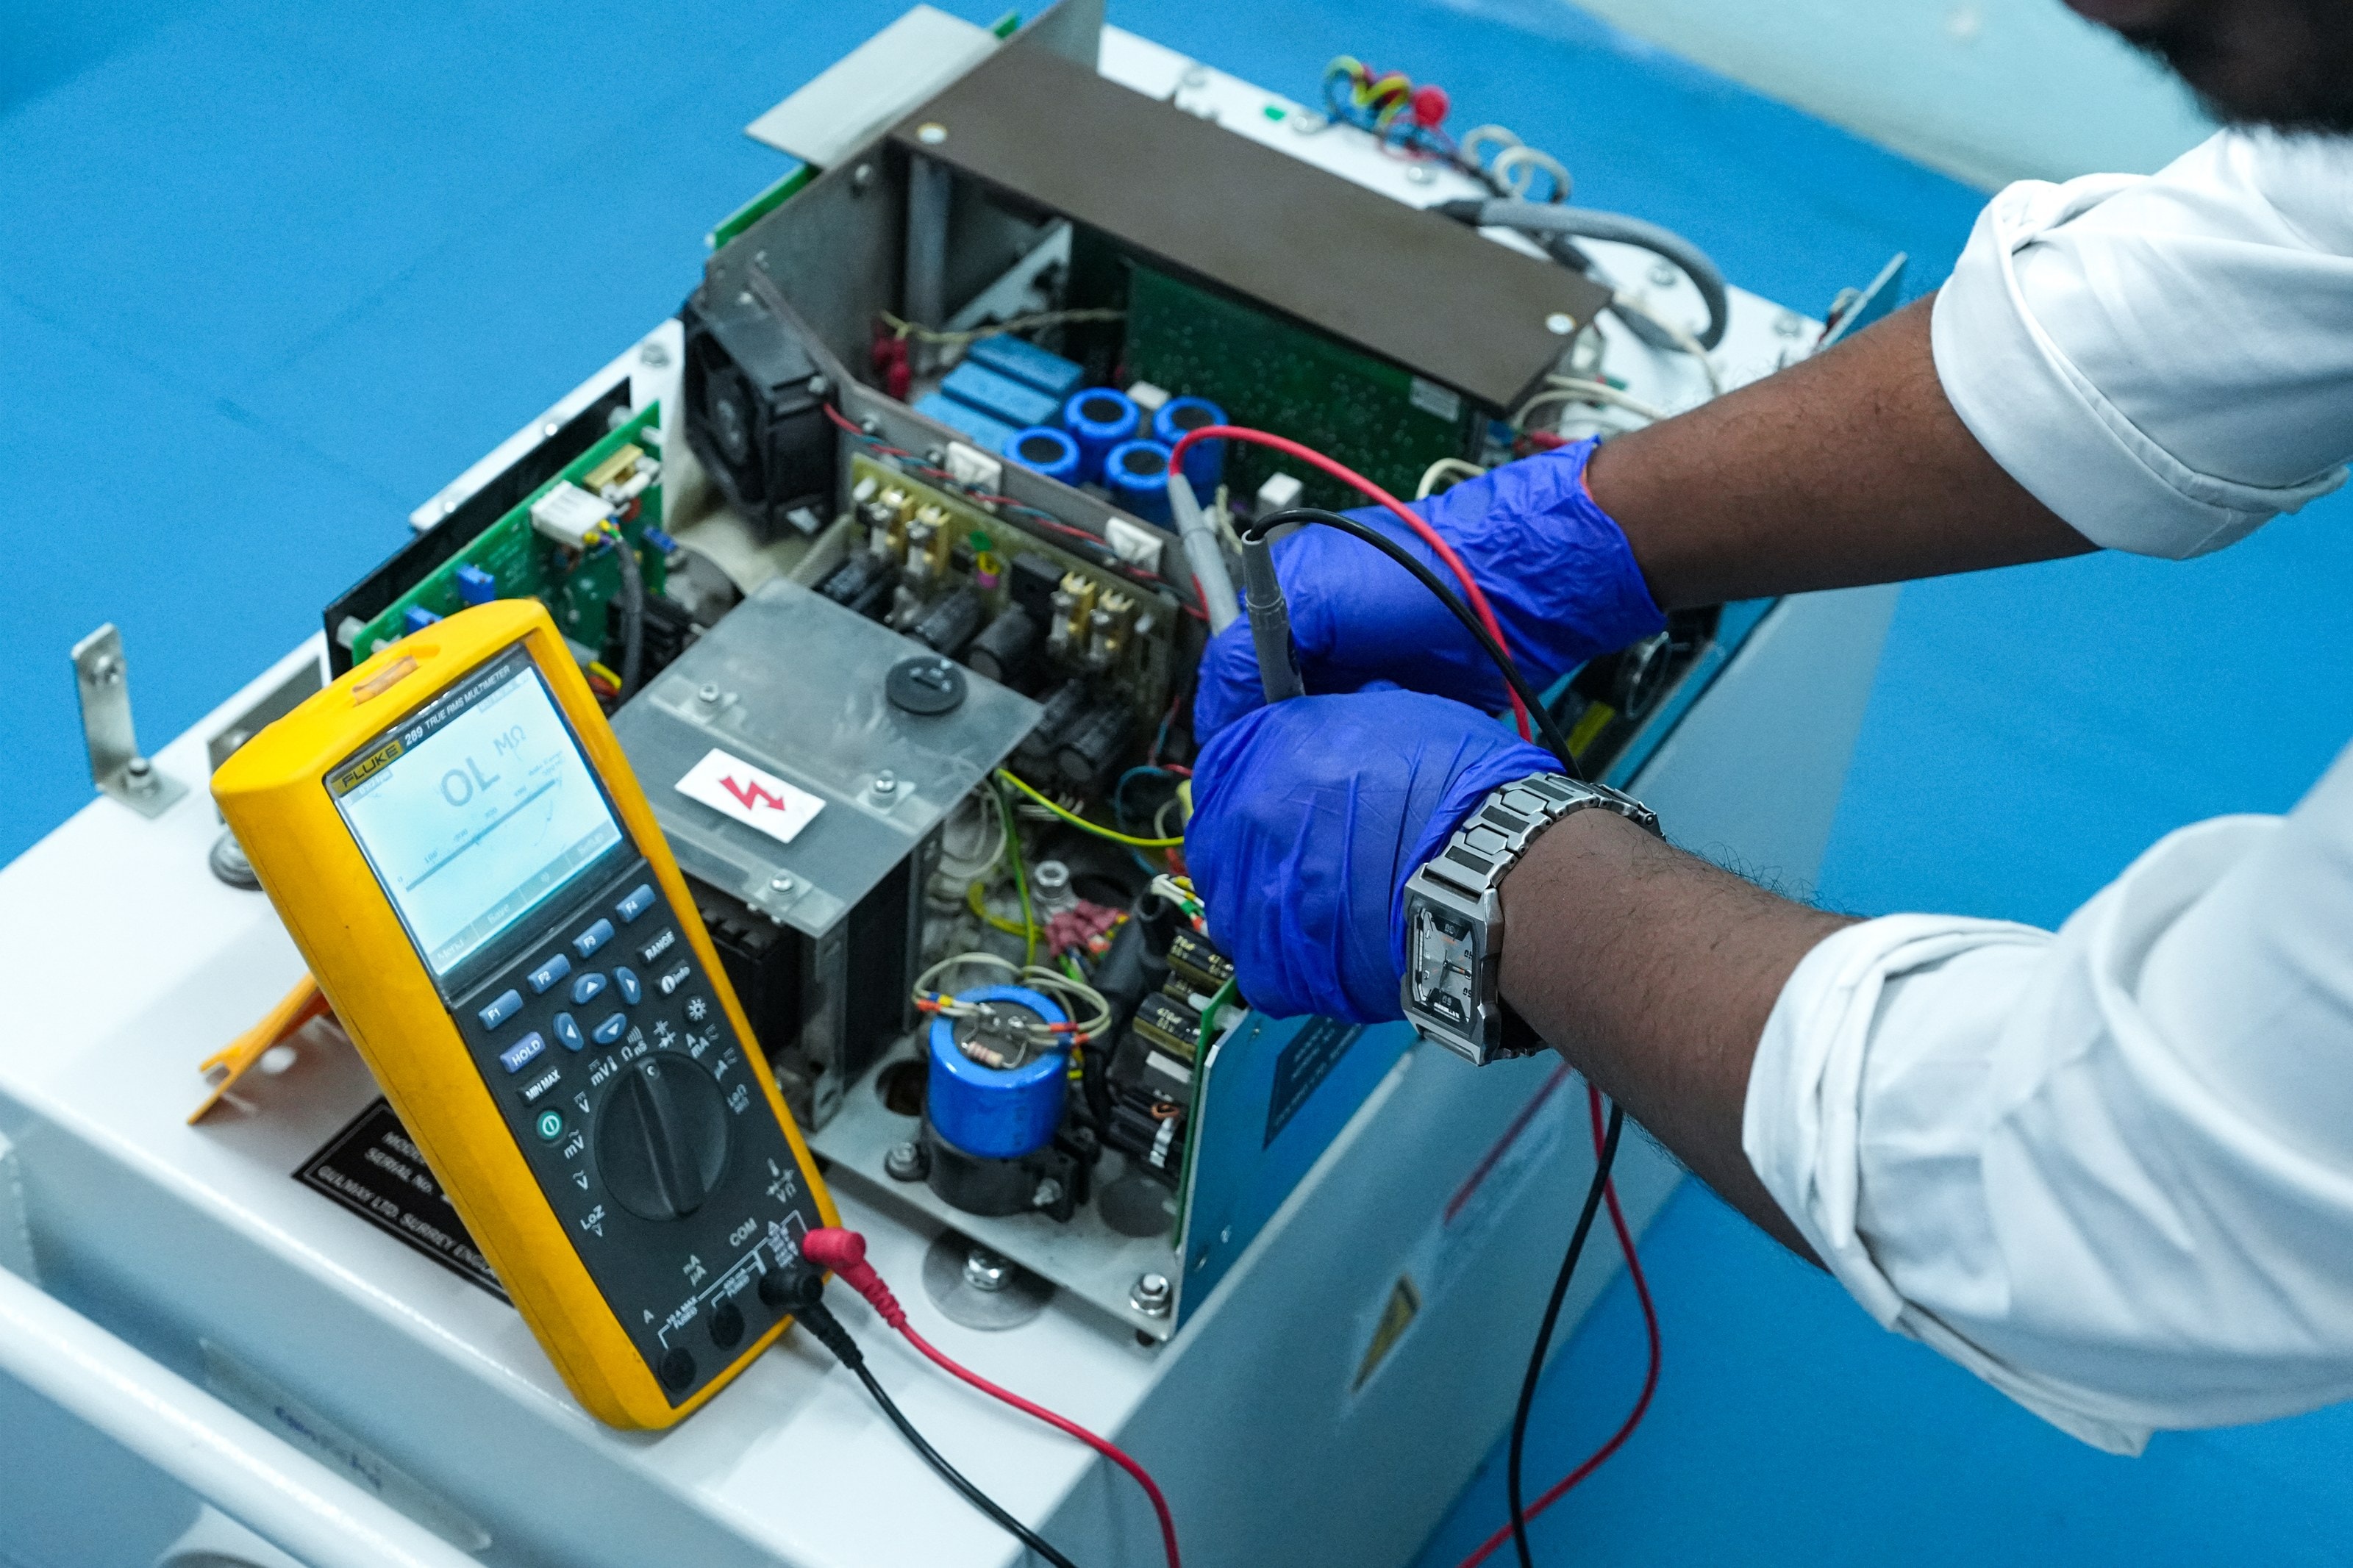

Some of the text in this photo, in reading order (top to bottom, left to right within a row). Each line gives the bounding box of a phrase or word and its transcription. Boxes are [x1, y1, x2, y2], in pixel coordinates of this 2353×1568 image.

[342, 665, 511, 787] FLUKE 289 TRUE RMS MULTIMETER
[440, 757, 501, 807] OL
[626, 901, 638, 912] F4
[584, 934, 596, 948] F3
[645, 931, 676, 961] RANGE
[538, 971, 551, 984] F2
[488, 1007, 501, 1020] F1
[512, 1039, 541, 1066] HOLD
[525, 1070, 561, 1100] MIN MAX
[580, 1204, 606, 1231] LoZ
[729, 1217, 757, 1247] COM
[643, 1309, 654, 1325] A
